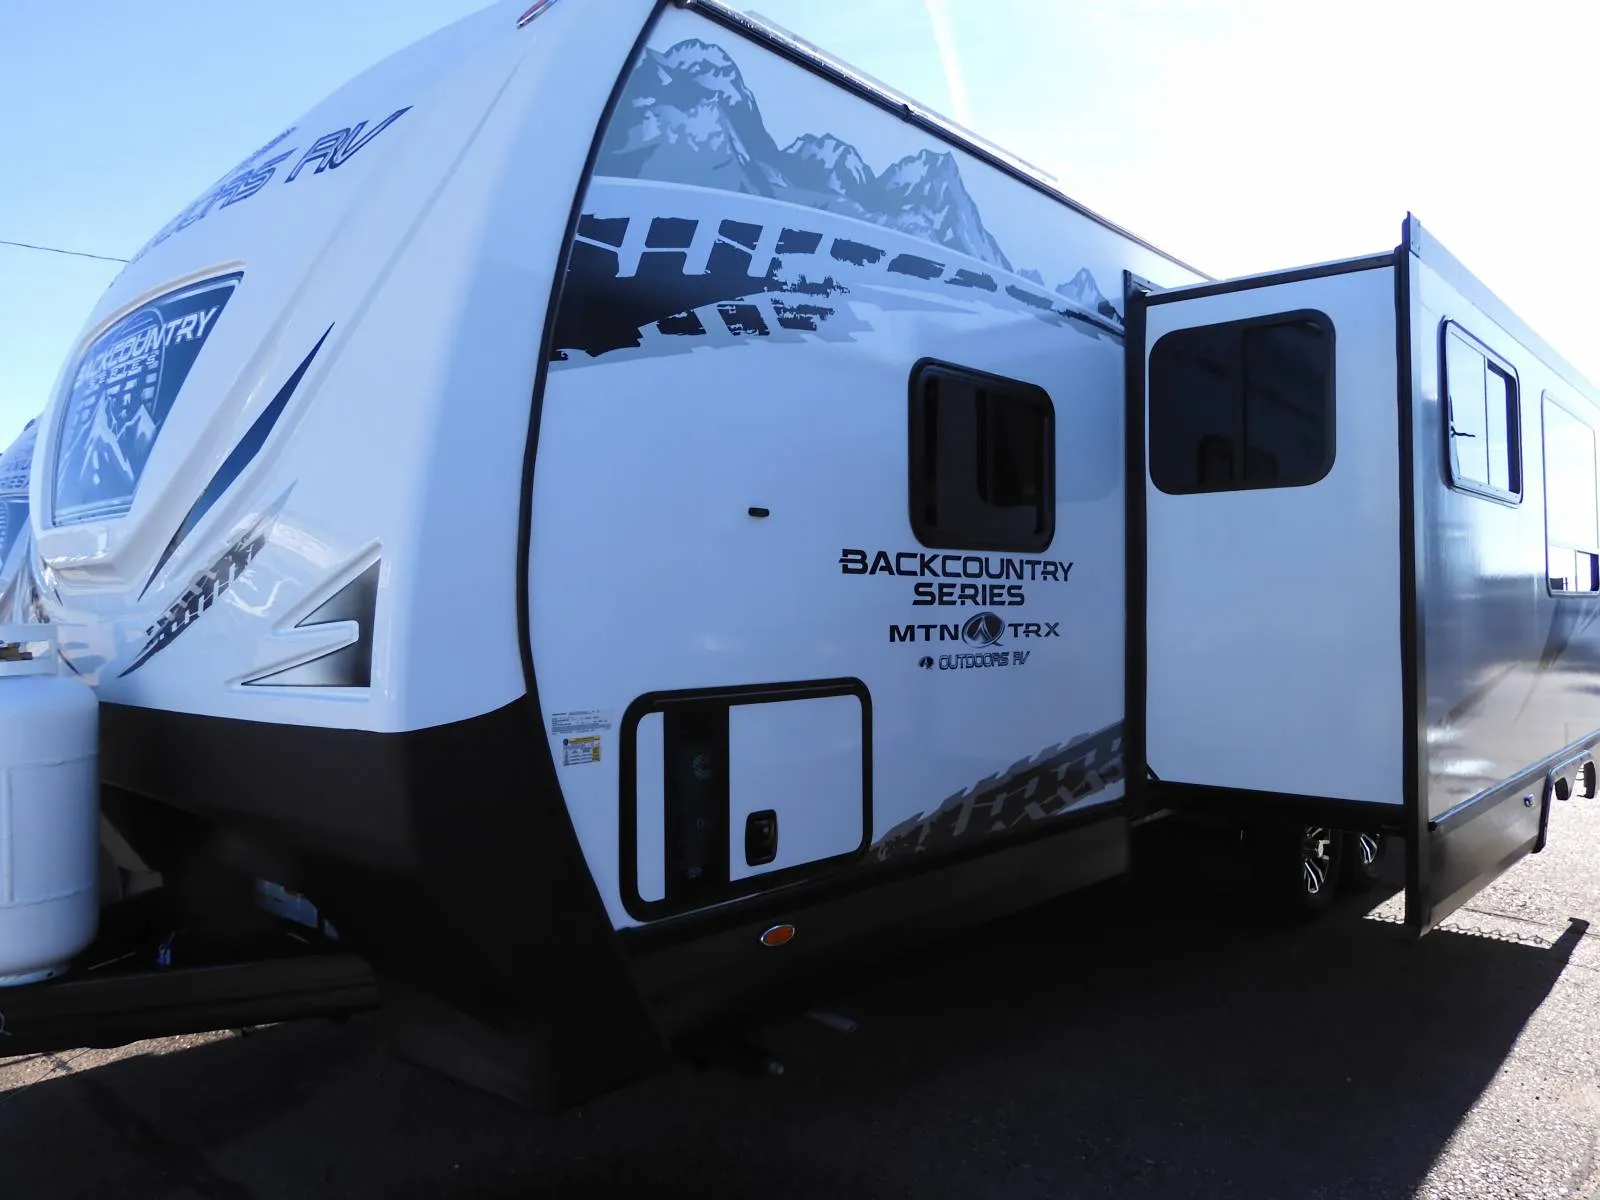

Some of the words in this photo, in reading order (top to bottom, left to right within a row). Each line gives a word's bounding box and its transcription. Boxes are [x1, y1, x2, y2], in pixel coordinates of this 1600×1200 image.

[285, 105, 414, 184] RV
[839, 548, 1074, 582] BACKCOUNTRY
[912, 582, 1026, 606] SERIES
[889, 624, 959, 643] MTN
[1008, 621, 1061, 638] TRX
[939, 651, 1010, 670] OUTDOORS
[1013, 650, 1031, 666] RV
